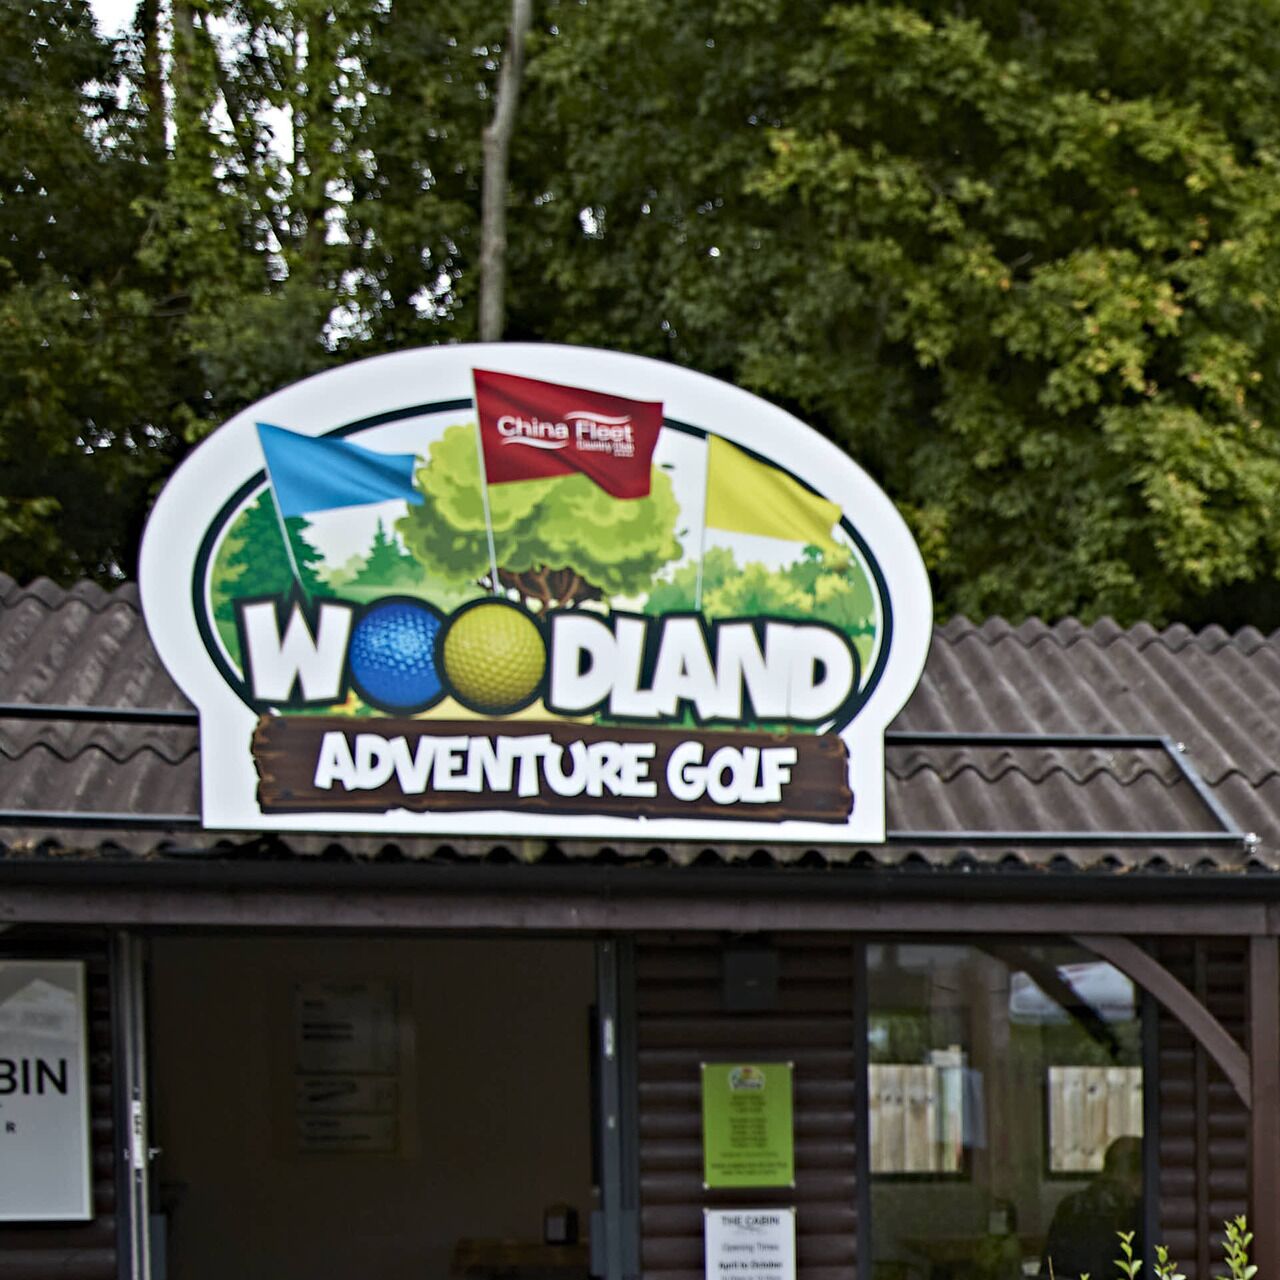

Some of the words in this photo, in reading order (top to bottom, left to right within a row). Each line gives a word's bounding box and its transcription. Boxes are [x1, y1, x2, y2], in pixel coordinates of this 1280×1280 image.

[497, 415, 569, 440] China
[575, 419, 634, 442] Fleet
[241, 597, 855, 720] WOODLAND
[313, 731, 658, 798] ADVENTURE
[666, 746, 799, 803] GOLF
[722, 1216, 742, 1225] THE
[744, 1216, 780, 1226] CABIN
